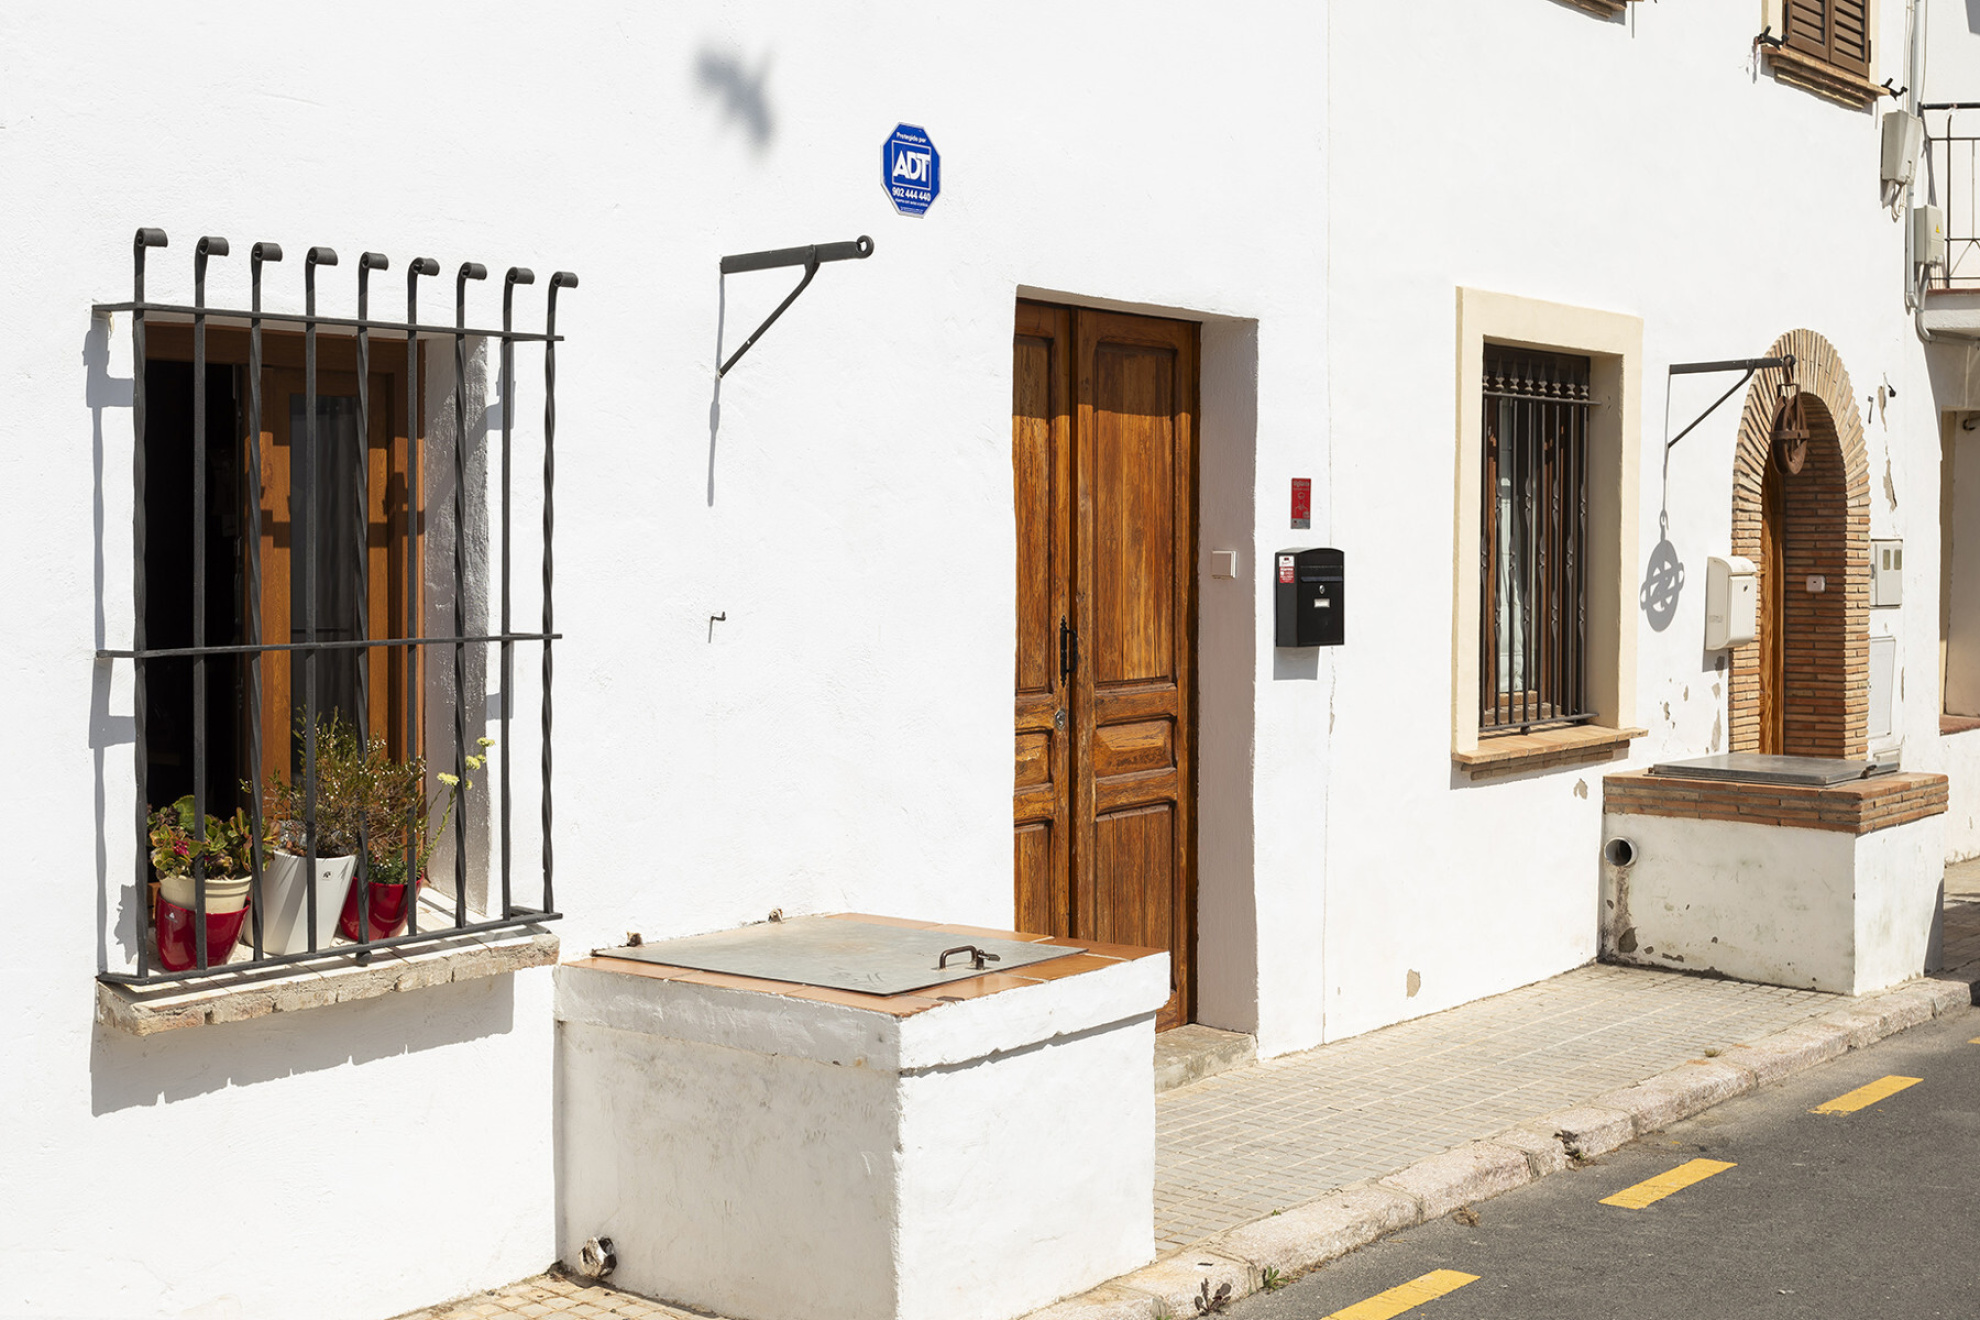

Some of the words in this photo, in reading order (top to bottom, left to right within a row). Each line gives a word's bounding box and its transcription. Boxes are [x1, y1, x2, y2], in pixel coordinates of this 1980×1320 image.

[892, 150, 931, 182] ADT
[891, 186, 905, 198] 902
[905, 188, 918, 200] 444
[918, 191, 932, 202] 440
